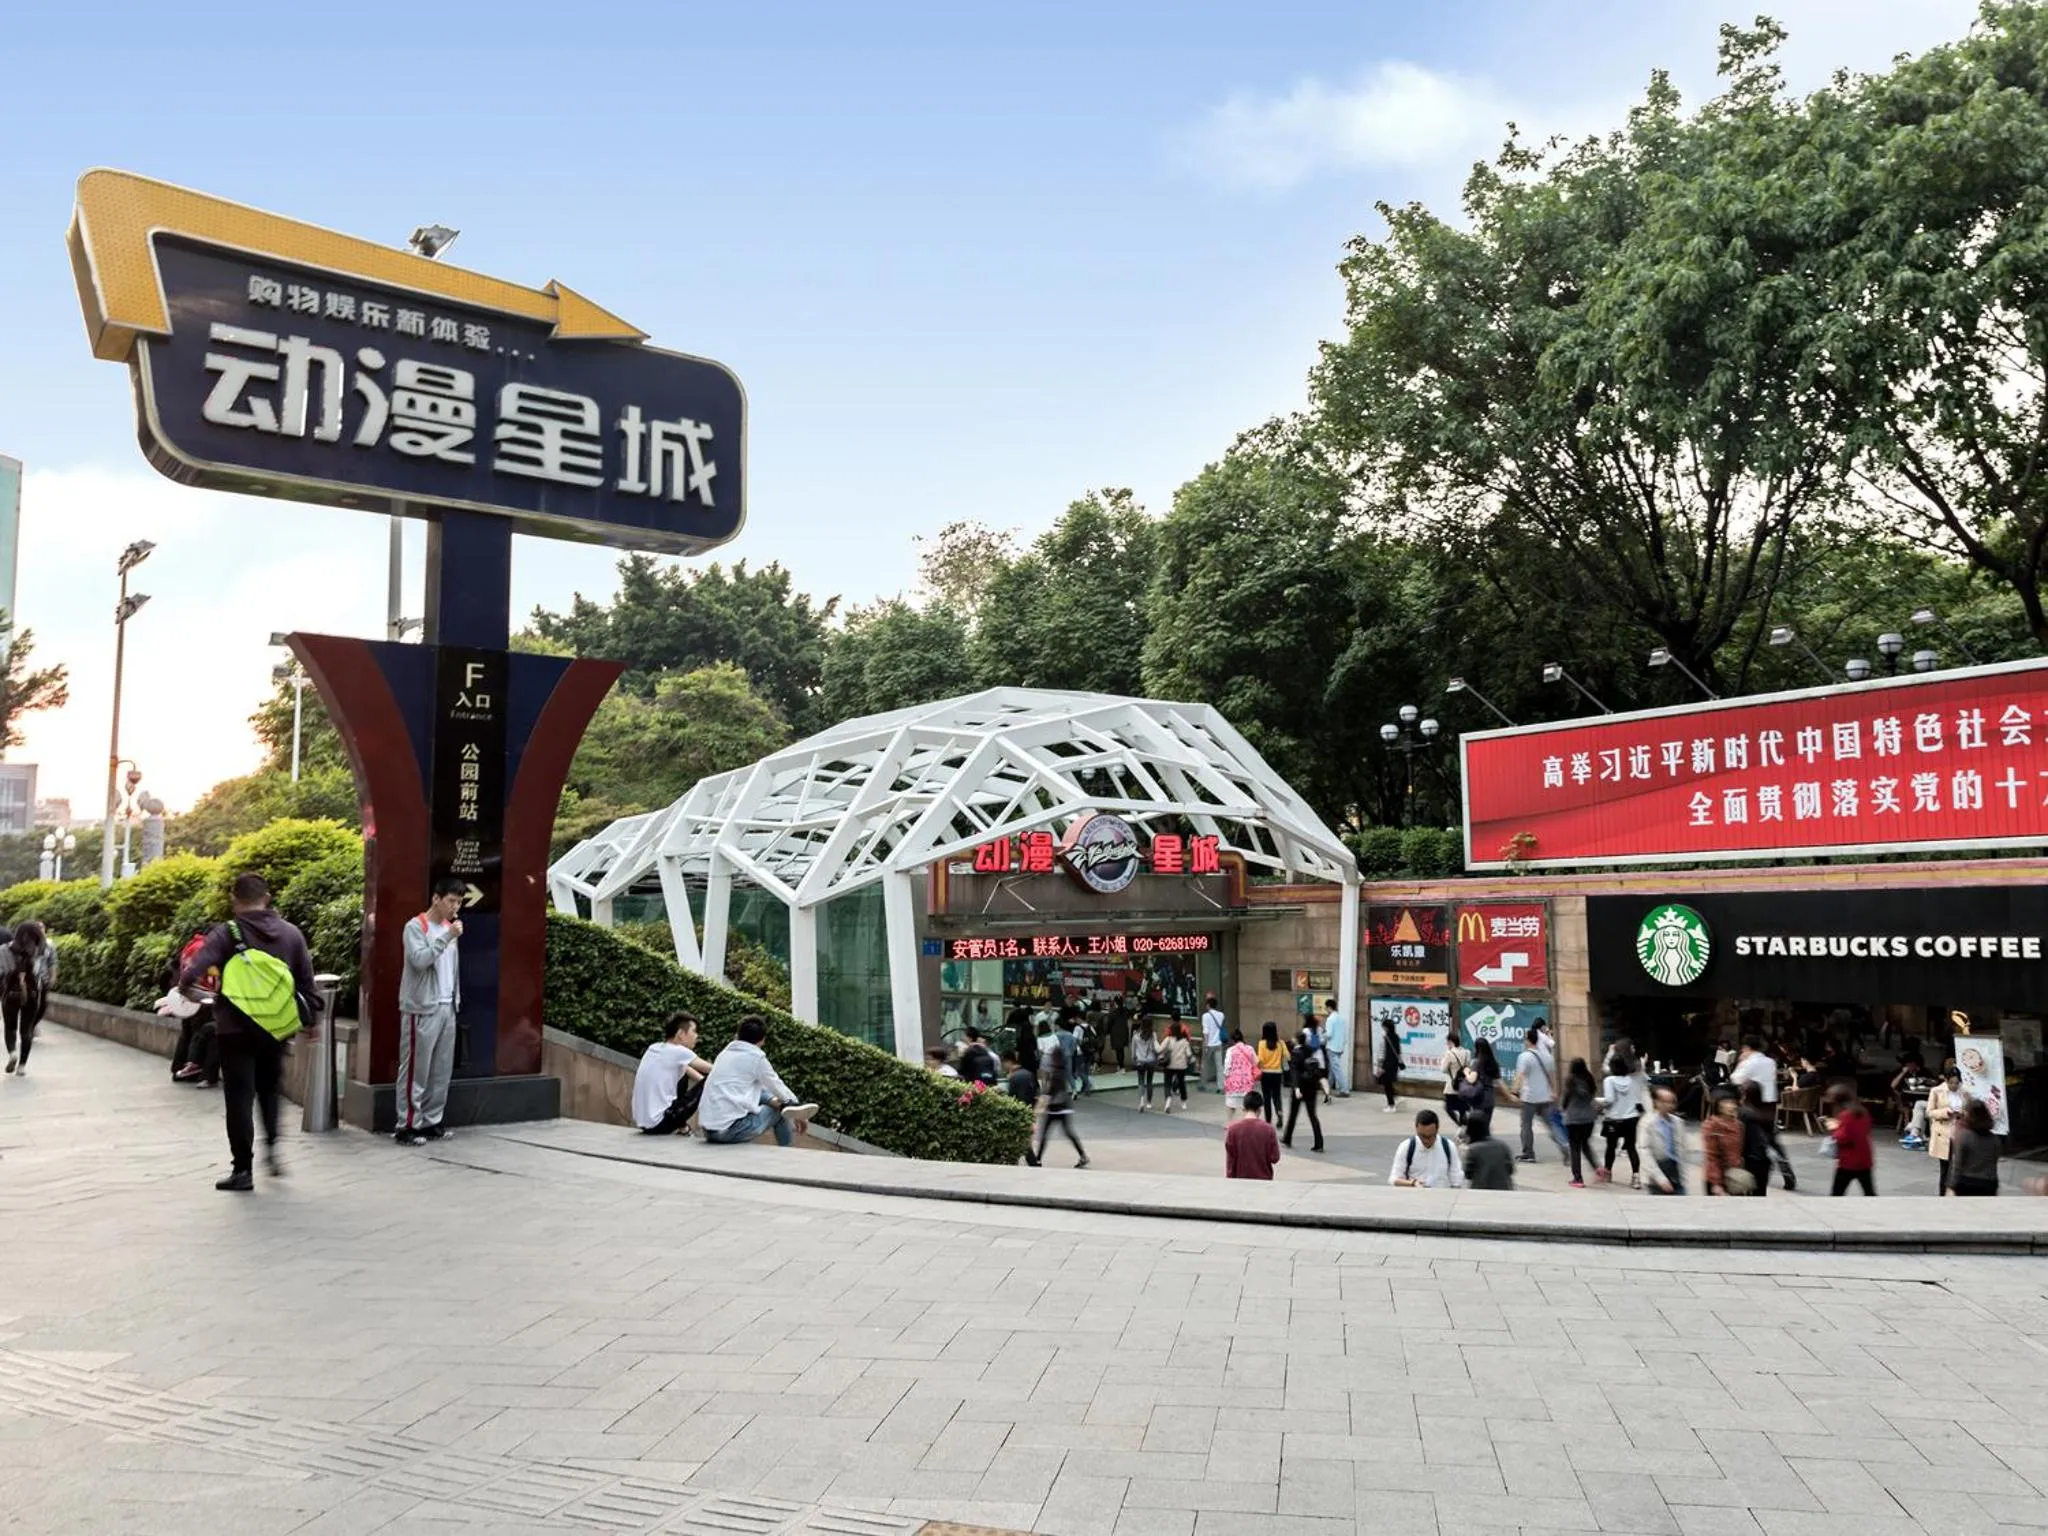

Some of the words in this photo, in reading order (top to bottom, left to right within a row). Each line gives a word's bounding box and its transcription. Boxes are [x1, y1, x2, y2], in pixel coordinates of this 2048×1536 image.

[202, 321, 719, 508] 动漫星城
[466, 663, 485, 688] F
[455, 691, 490, 708] 入口
[1543, 703, 2048, 788] 高举习近平新时代中国特色社会
[458, 743, 481, 820] 公园前站
[974, 831, 1054, 873] 动漫
[1152, 833, 1221, 873] 星城
[1490, 916, 1540, 937] 麦当劳
[1133, 936, 1208, 951] 020-62681999
[1735, 935, 1909, 957] STARBUCKS
[1914, 935, 2042, 959] COFFEE
[1471, 1019, 1498, 1037] Yes
